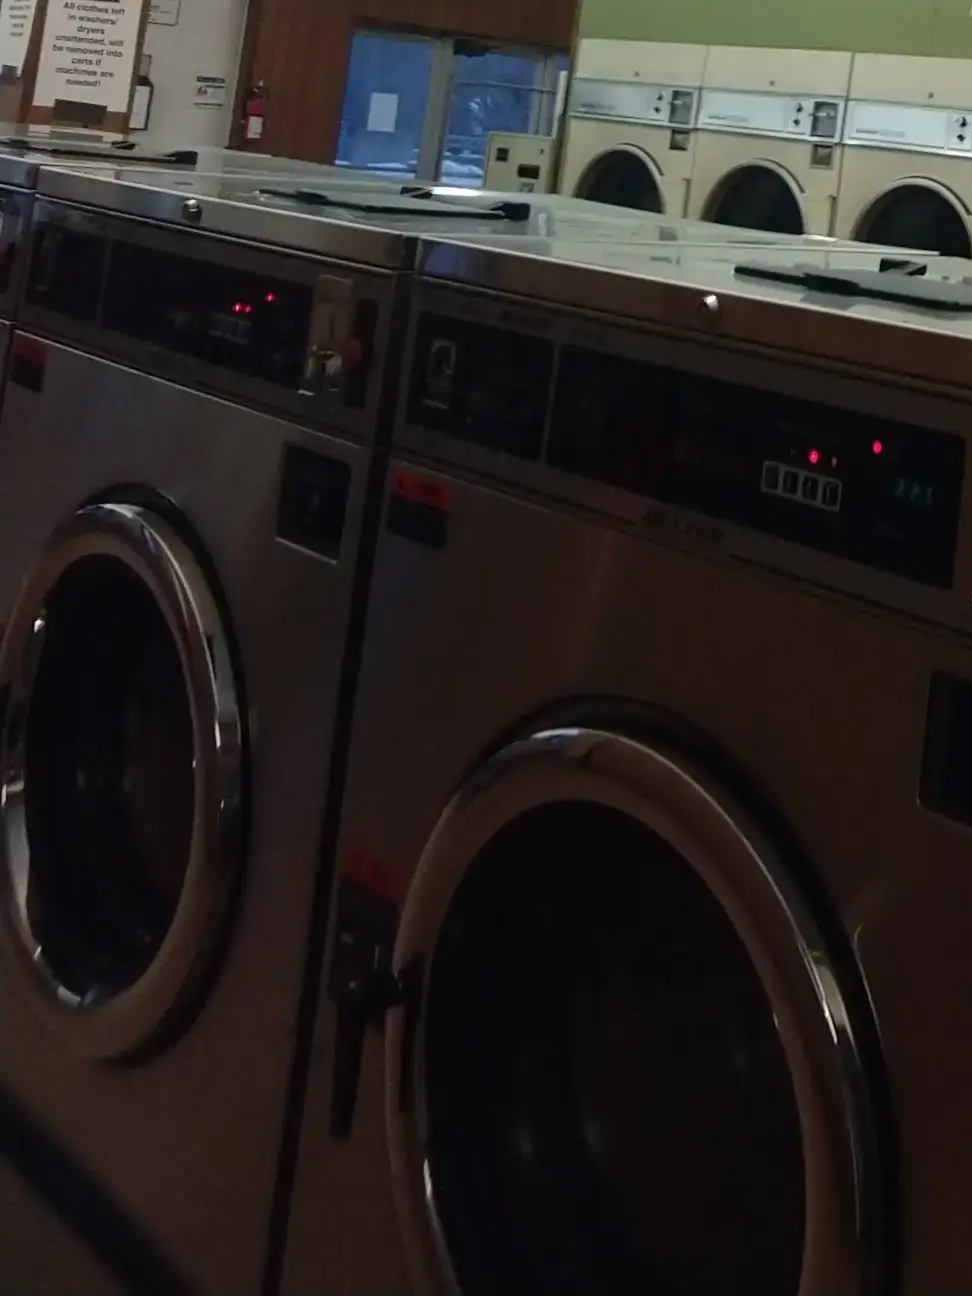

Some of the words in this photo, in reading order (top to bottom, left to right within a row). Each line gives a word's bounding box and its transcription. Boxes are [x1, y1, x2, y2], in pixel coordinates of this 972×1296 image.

[77, 4, 109, 14] clothes
[77, 25, 105, 35] dryers
[66, 46, 104, 56] removed
[106, 50, 123, 58] into
[71, 57, 93, 65] carts
[55, 67, 97, 77] machines
